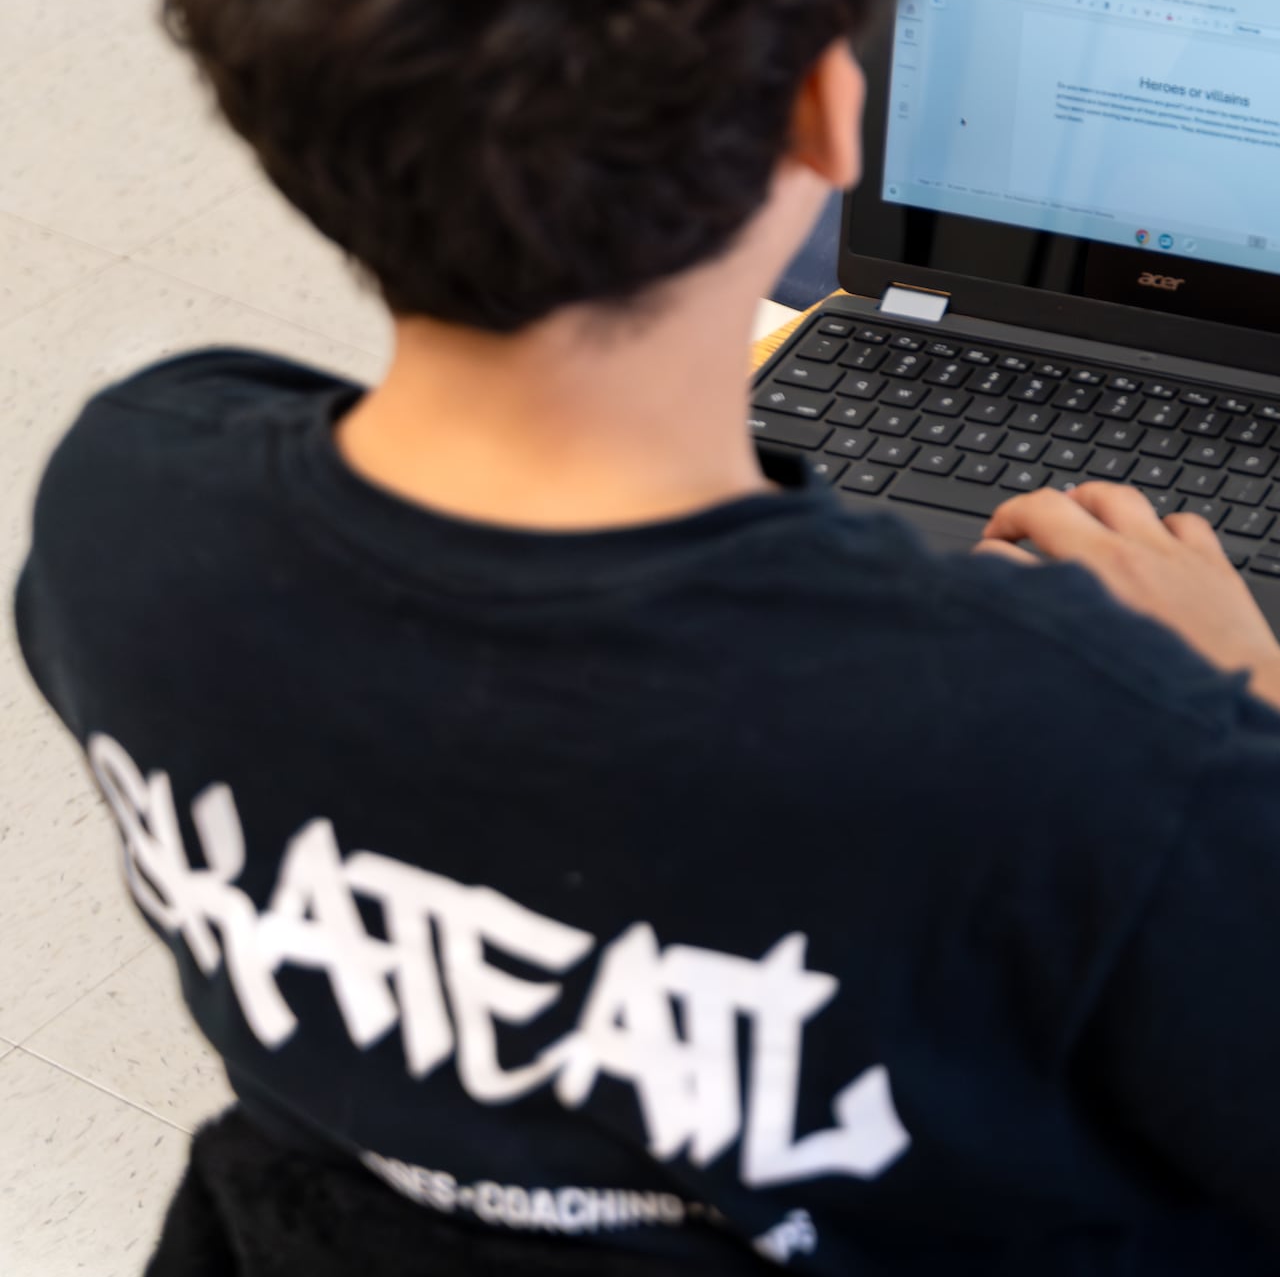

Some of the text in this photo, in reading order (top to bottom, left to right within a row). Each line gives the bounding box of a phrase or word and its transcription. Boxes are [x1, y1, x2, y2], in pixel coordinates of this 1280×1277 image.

[1139, 76, 1186, 96] Heroes
[1188, 86, 1202, 98] or
[1137, 272, 1186, 292] acer
